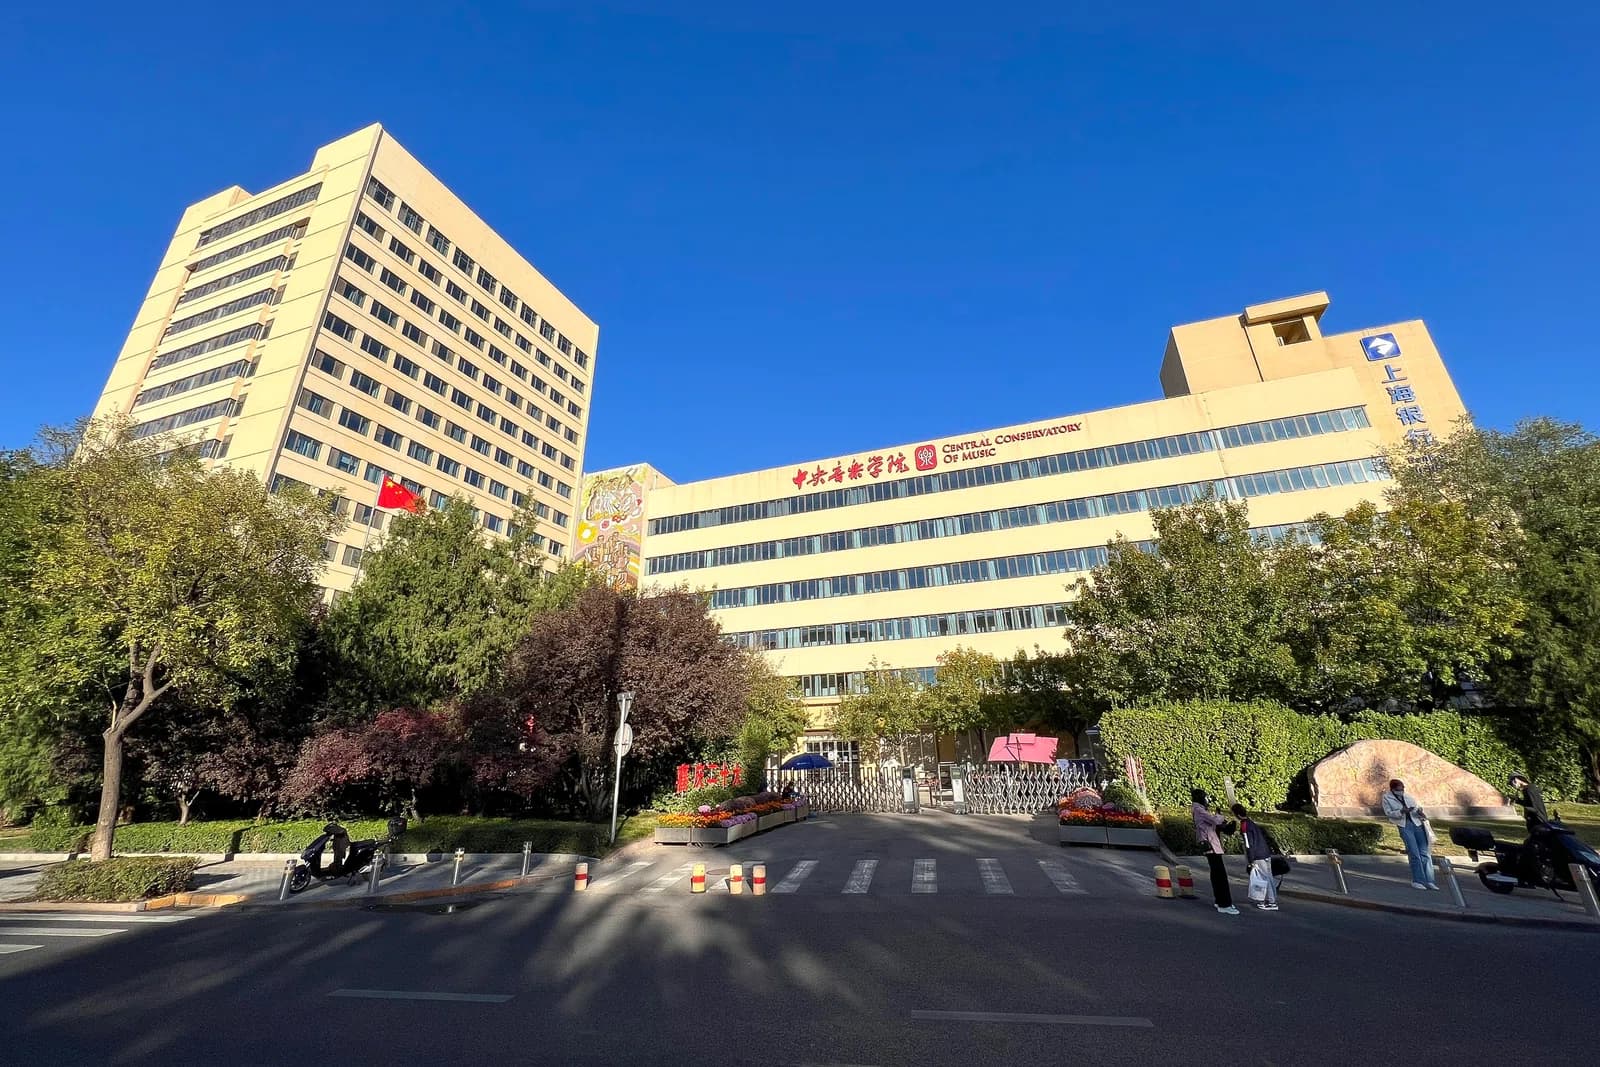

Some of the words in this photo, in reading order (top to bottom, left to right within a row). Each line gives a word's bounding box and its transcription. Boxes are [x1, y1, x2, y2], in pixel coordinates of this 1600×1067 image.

[942, 436, 992, 453] CENTRAL
[995, 422, 1082, 445] CONSERVATORY
[943, 454, 959, 464] OF
[962, 448, 996, 462] MUSIC
